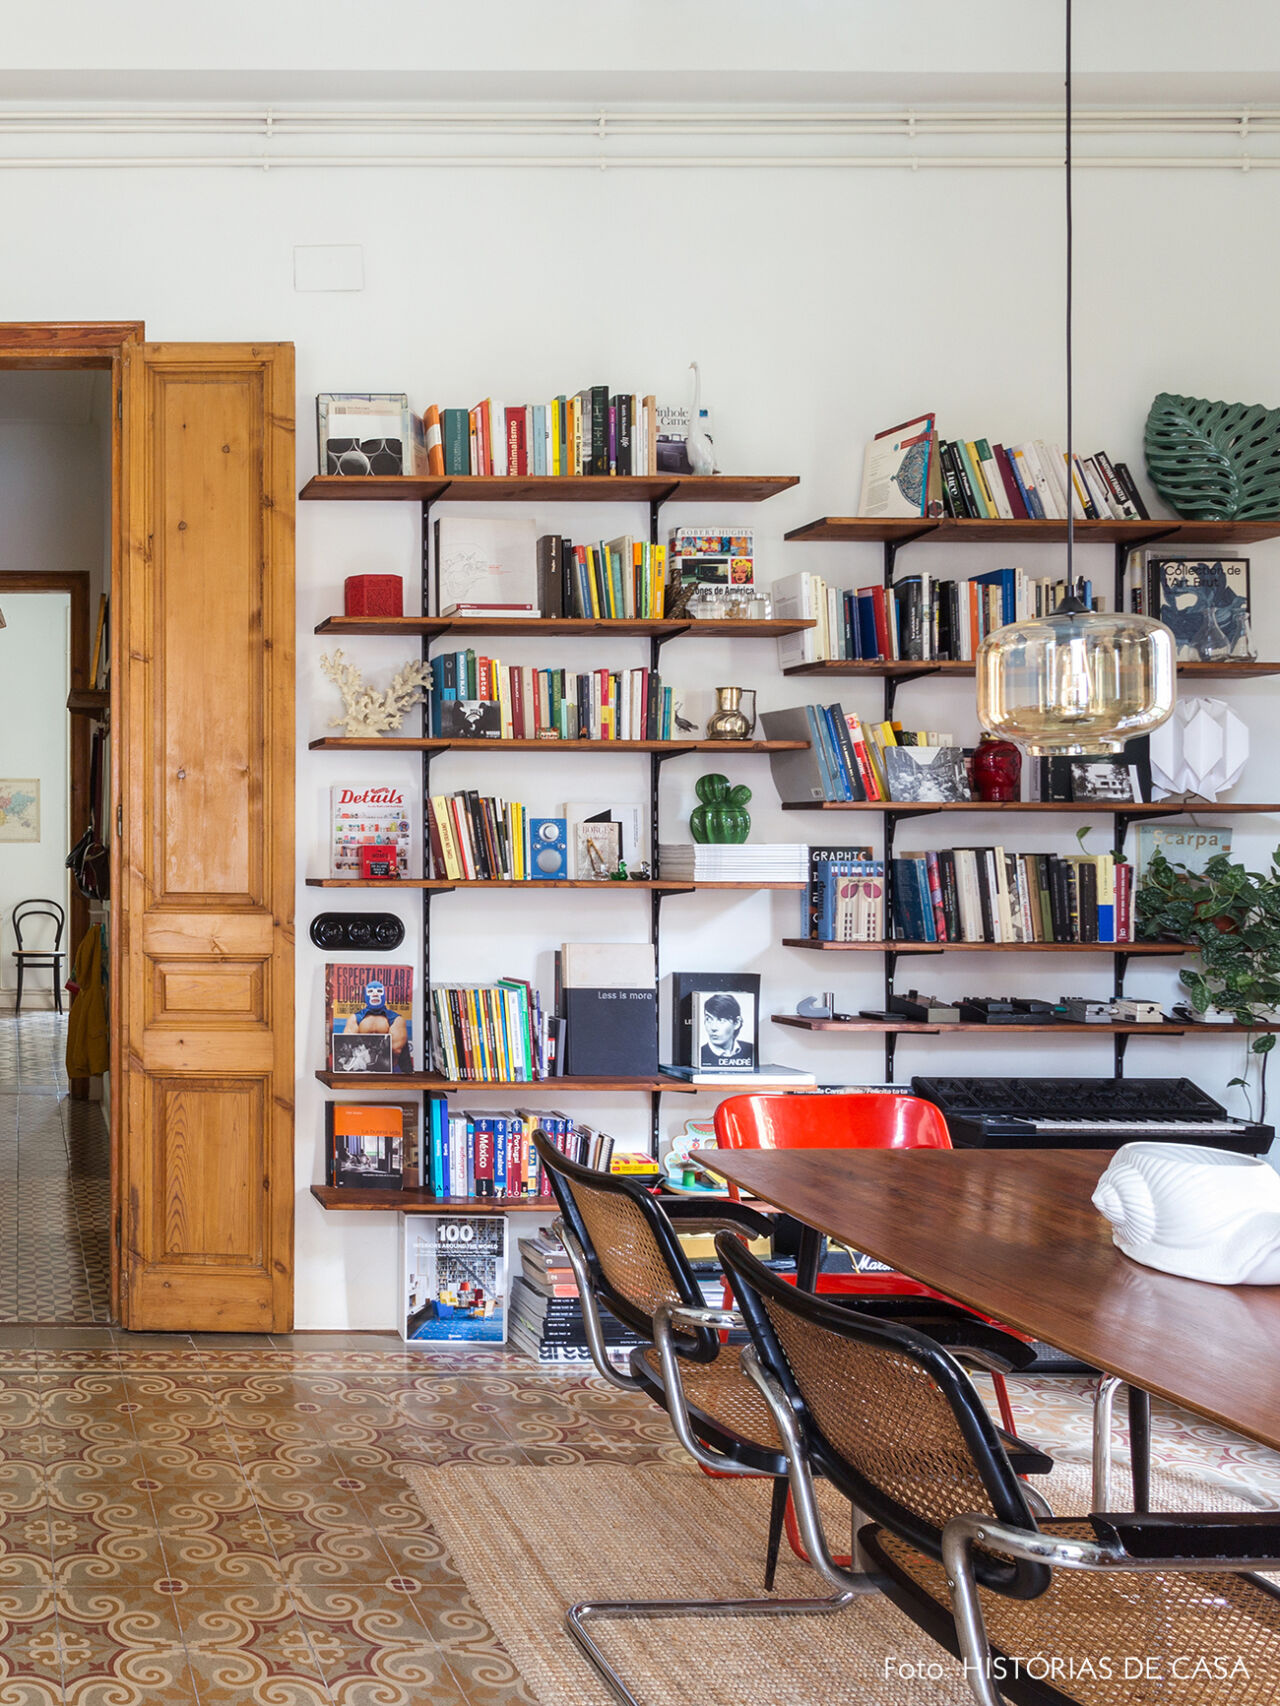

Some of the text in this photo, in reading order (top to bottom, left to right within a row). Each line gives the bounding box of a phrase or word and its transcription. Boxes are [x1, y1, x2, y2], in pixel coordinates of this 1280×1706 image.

[656, 406, 688, 418] inhole
[661, 417, 690, 426] Came
[509, 420, 518, 476] Minimalismo
[1165, 564, 1241, 576] Collection de
[715, 586, 724, 595] de
[1193, 578, 1221, 588] Brut
[338, 789, 404, 804] Details
[582, 826, 615, 834] BORGES
[1152, 829, 1219, 850] Scarpa
[812, 851, 867, 861] GRAPHIC
[387, 986, 410, 1005] LIBRE
[597, 991, 617, 1000] Less
[620, 991, 628, 1000] is
[478, 1133, 488, 1168] México
[496, 1134, 504, 1176] New Zealand
[512, 1134, 520, 1163] Portugal
[437, 1224, 474, 1242] 100
[852, 1254, 895, 1272] Mars
